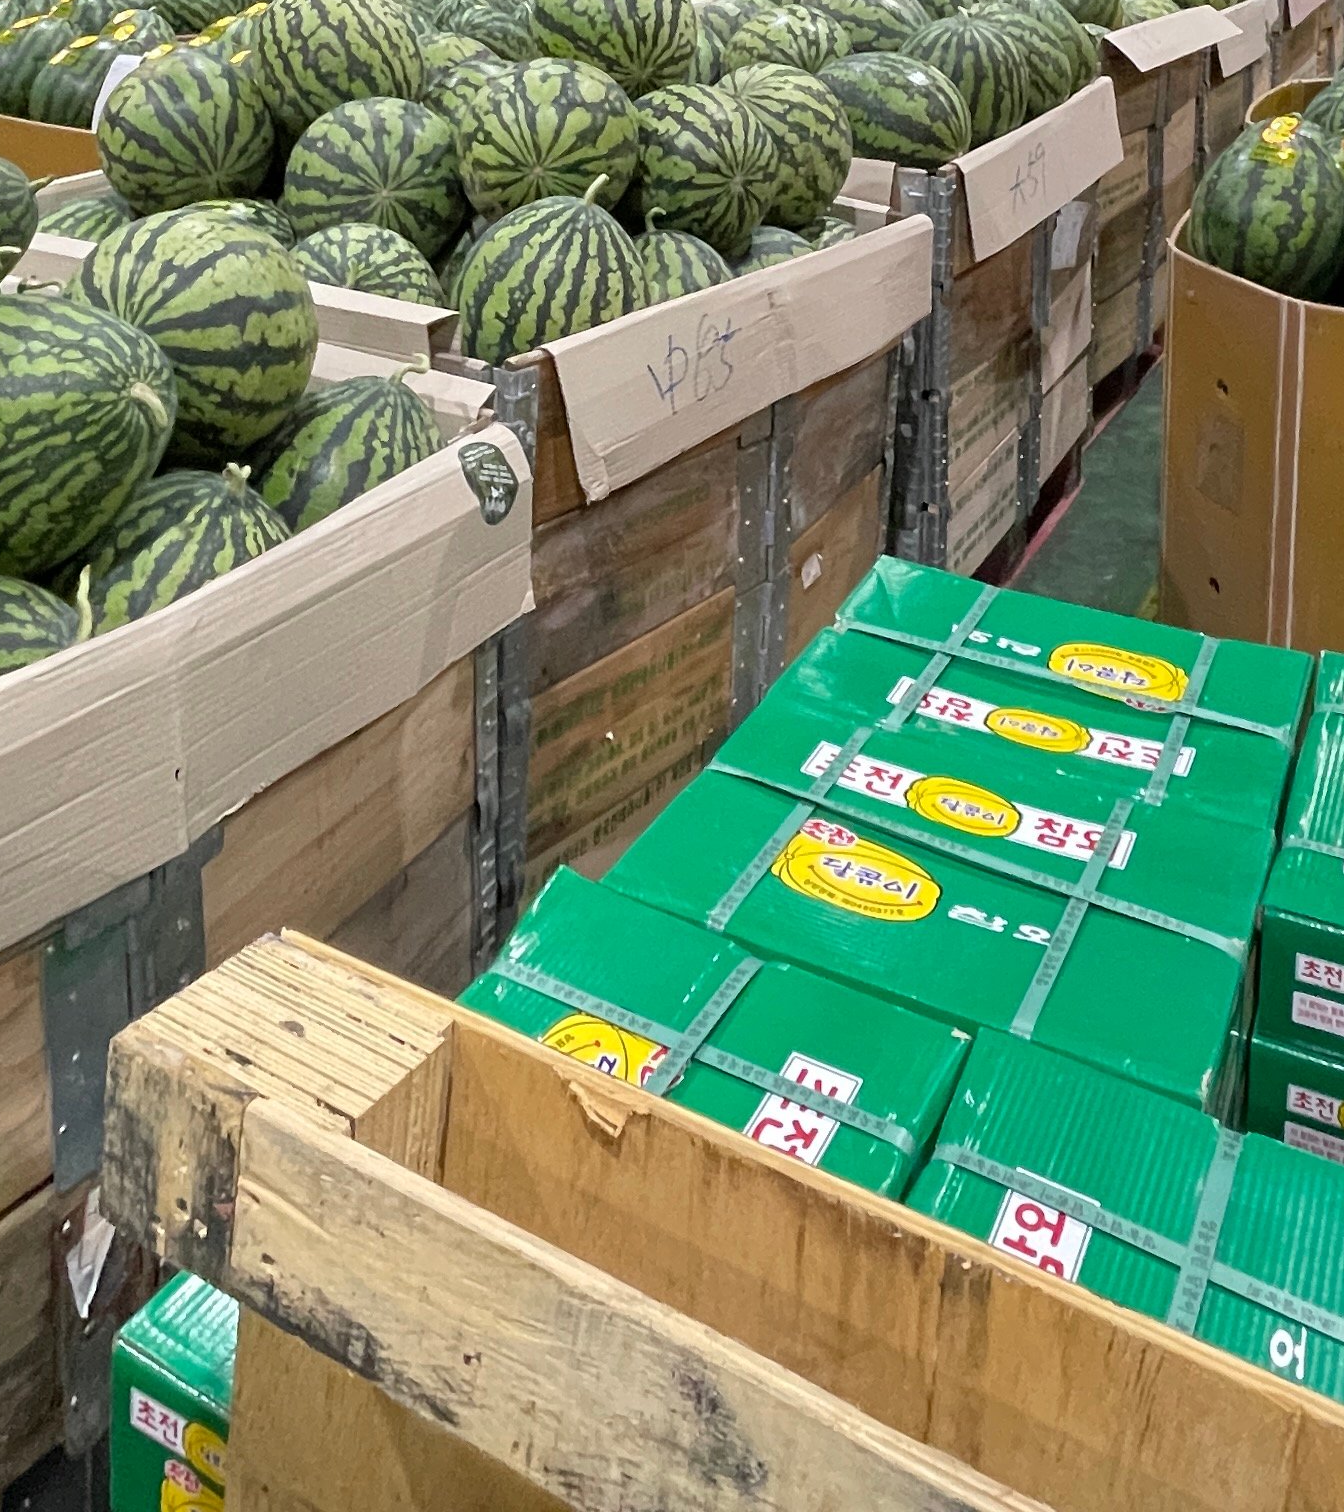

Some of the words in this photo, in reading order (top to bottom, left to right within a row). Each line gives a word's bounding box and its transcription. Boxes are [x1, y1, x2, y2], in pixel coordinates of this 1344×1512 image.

[1301, 959, 1343, 990] 초전
[1293, 1090, 1334, 1122] 초전
[136, 1398, 179, 1448] 초전
